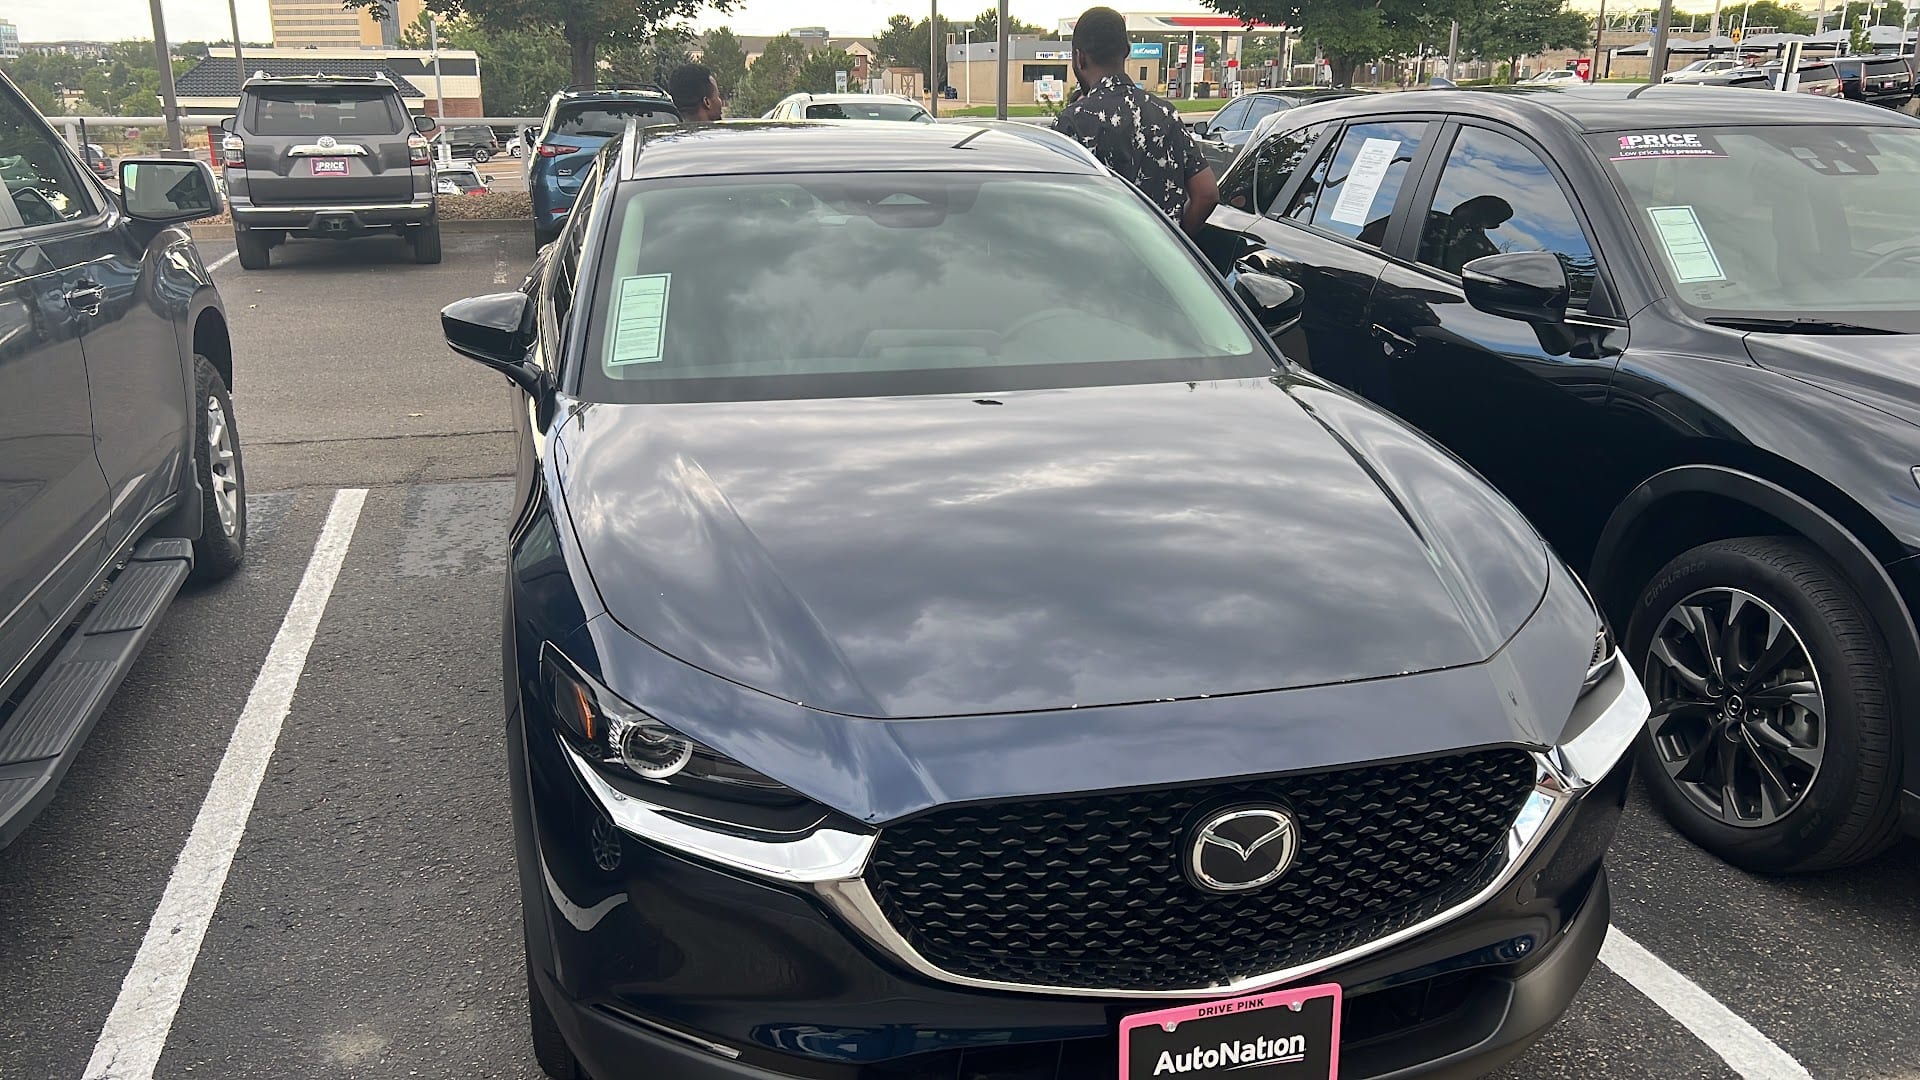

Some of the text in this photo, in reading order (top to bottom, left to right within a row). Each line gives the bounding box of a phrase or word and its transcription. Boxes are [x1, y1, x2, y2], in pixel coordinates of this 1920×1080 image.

[1618, 134, 1701, 146] 1PRICE
[1198, 998, 1265, 1017] DRIVE PINK
[1153, 1034, 1306, 1076] AutoNation
